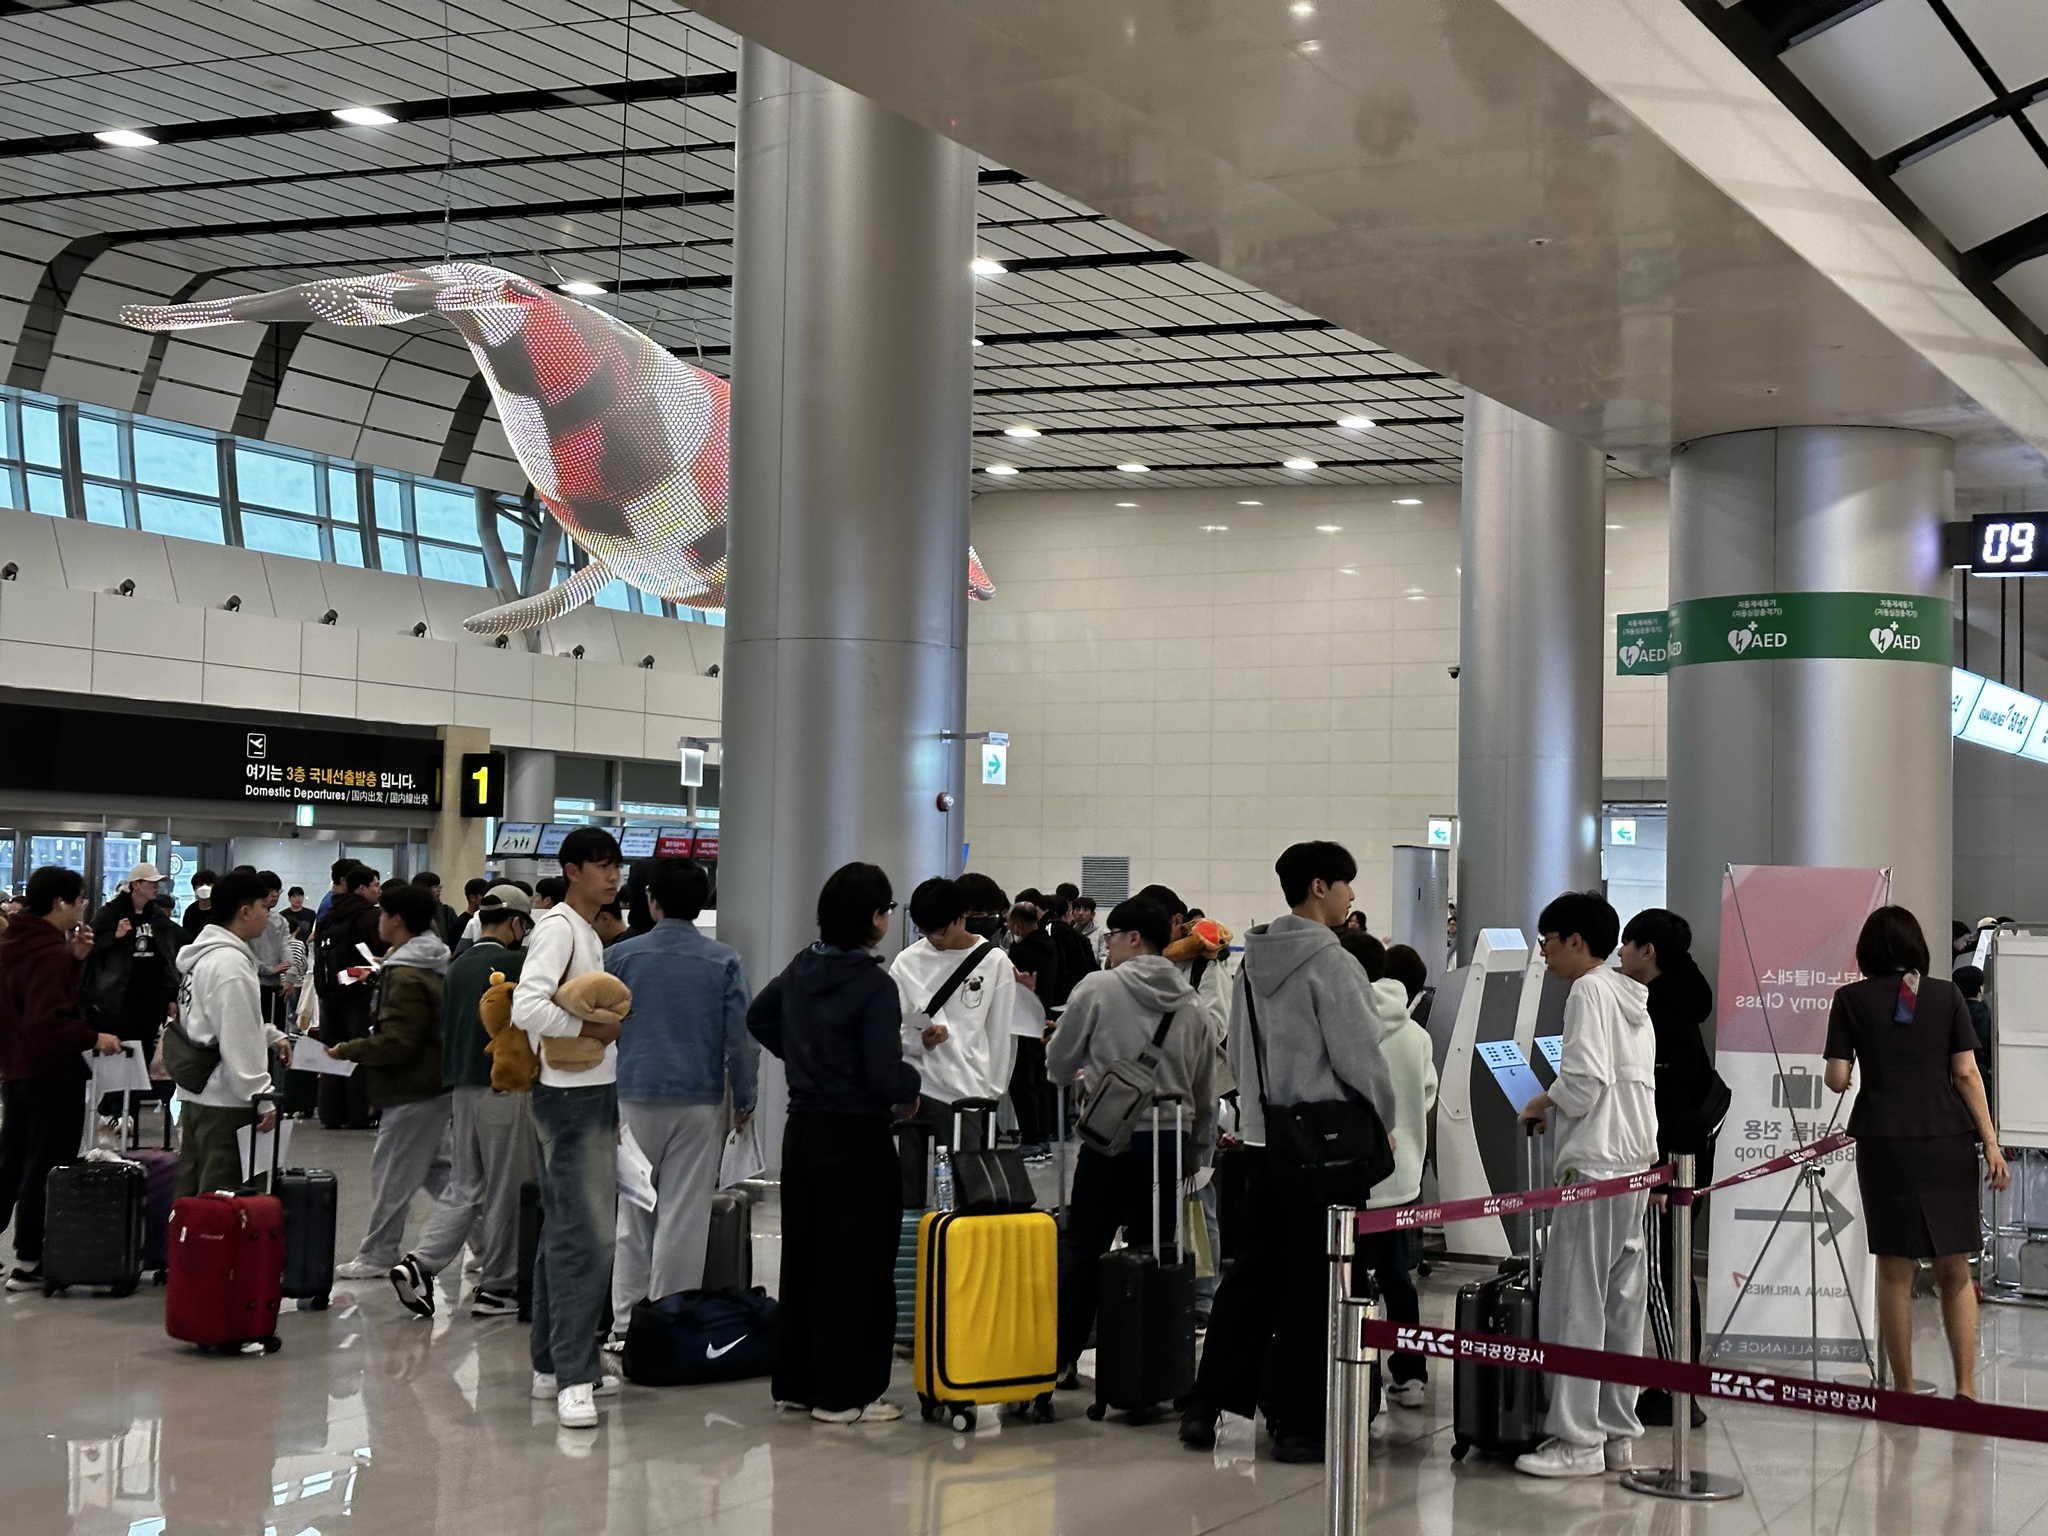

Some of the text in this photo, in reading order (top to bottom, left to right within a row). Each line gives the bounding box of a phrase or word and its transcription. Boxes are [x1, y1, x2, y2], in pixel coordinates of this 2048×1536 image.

[1982, 522, 2036, 563] 09
[1751, 633, 1788, 648] AED
[1892, 634, 1921, 650] AED
[1639, 648, 1667, 662] AED
[246, 763, 416, 790] 여기는 3층 국내선출발층 입니다.
[472, 766, 488, 805] 1
[245, 784, 291, 797] Domestic
[1396, 1327, 1546, 1365] KAC 한국공항공사
[1710, 1371, 1878, 1412] KAC 한국공항공사
